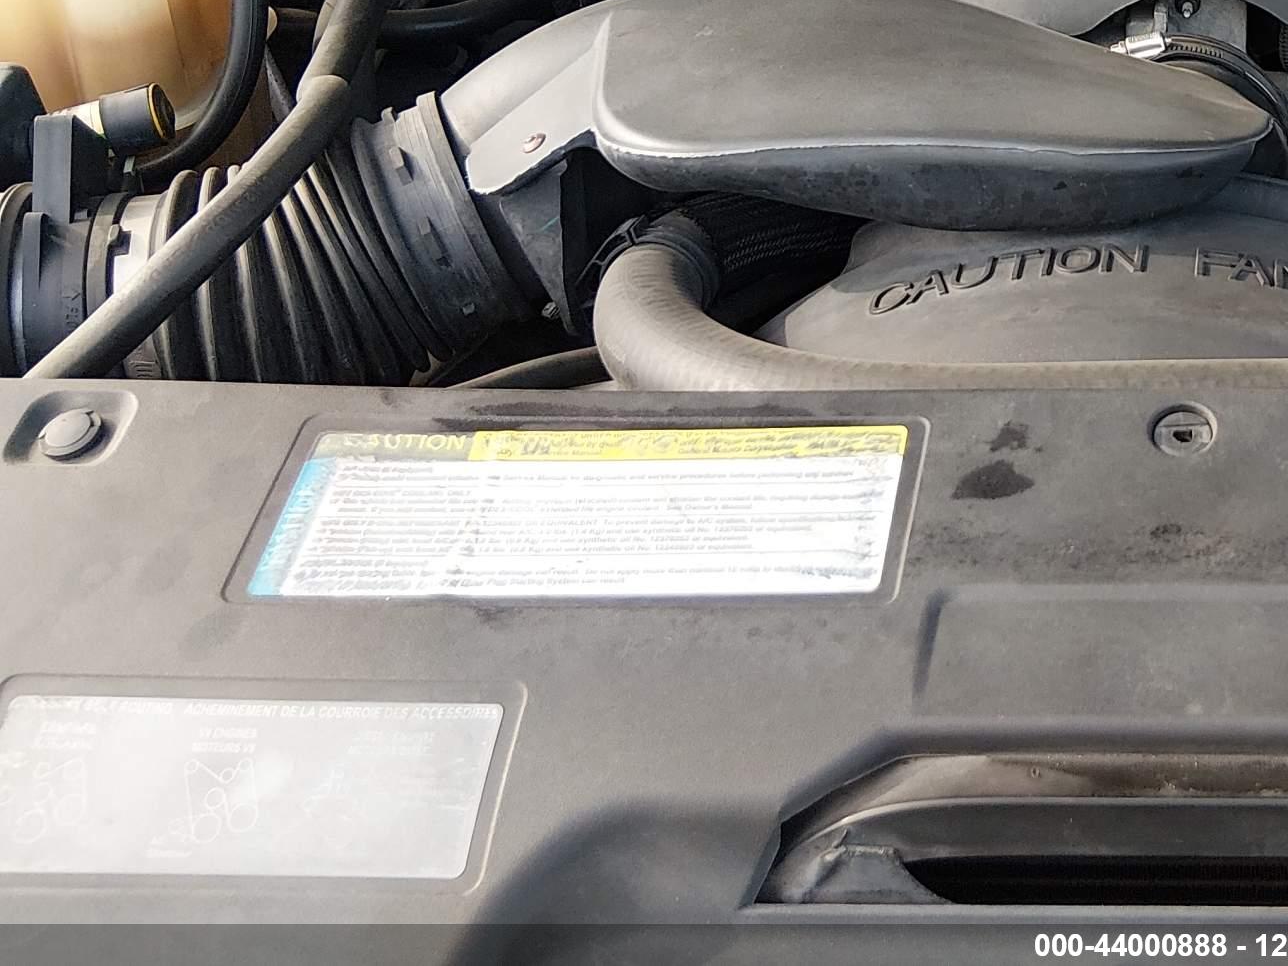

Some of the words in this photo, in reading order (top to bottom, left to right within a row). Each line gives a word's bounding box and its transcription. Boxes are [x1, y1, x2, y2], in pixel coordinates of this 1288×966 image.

[868, 243, 1150, 315] CAUTION
[184, 703, 278, 717] ACHEMINEMENT
[280, 705, 299, 717] DE
[300, 705, 316, 717] LA
